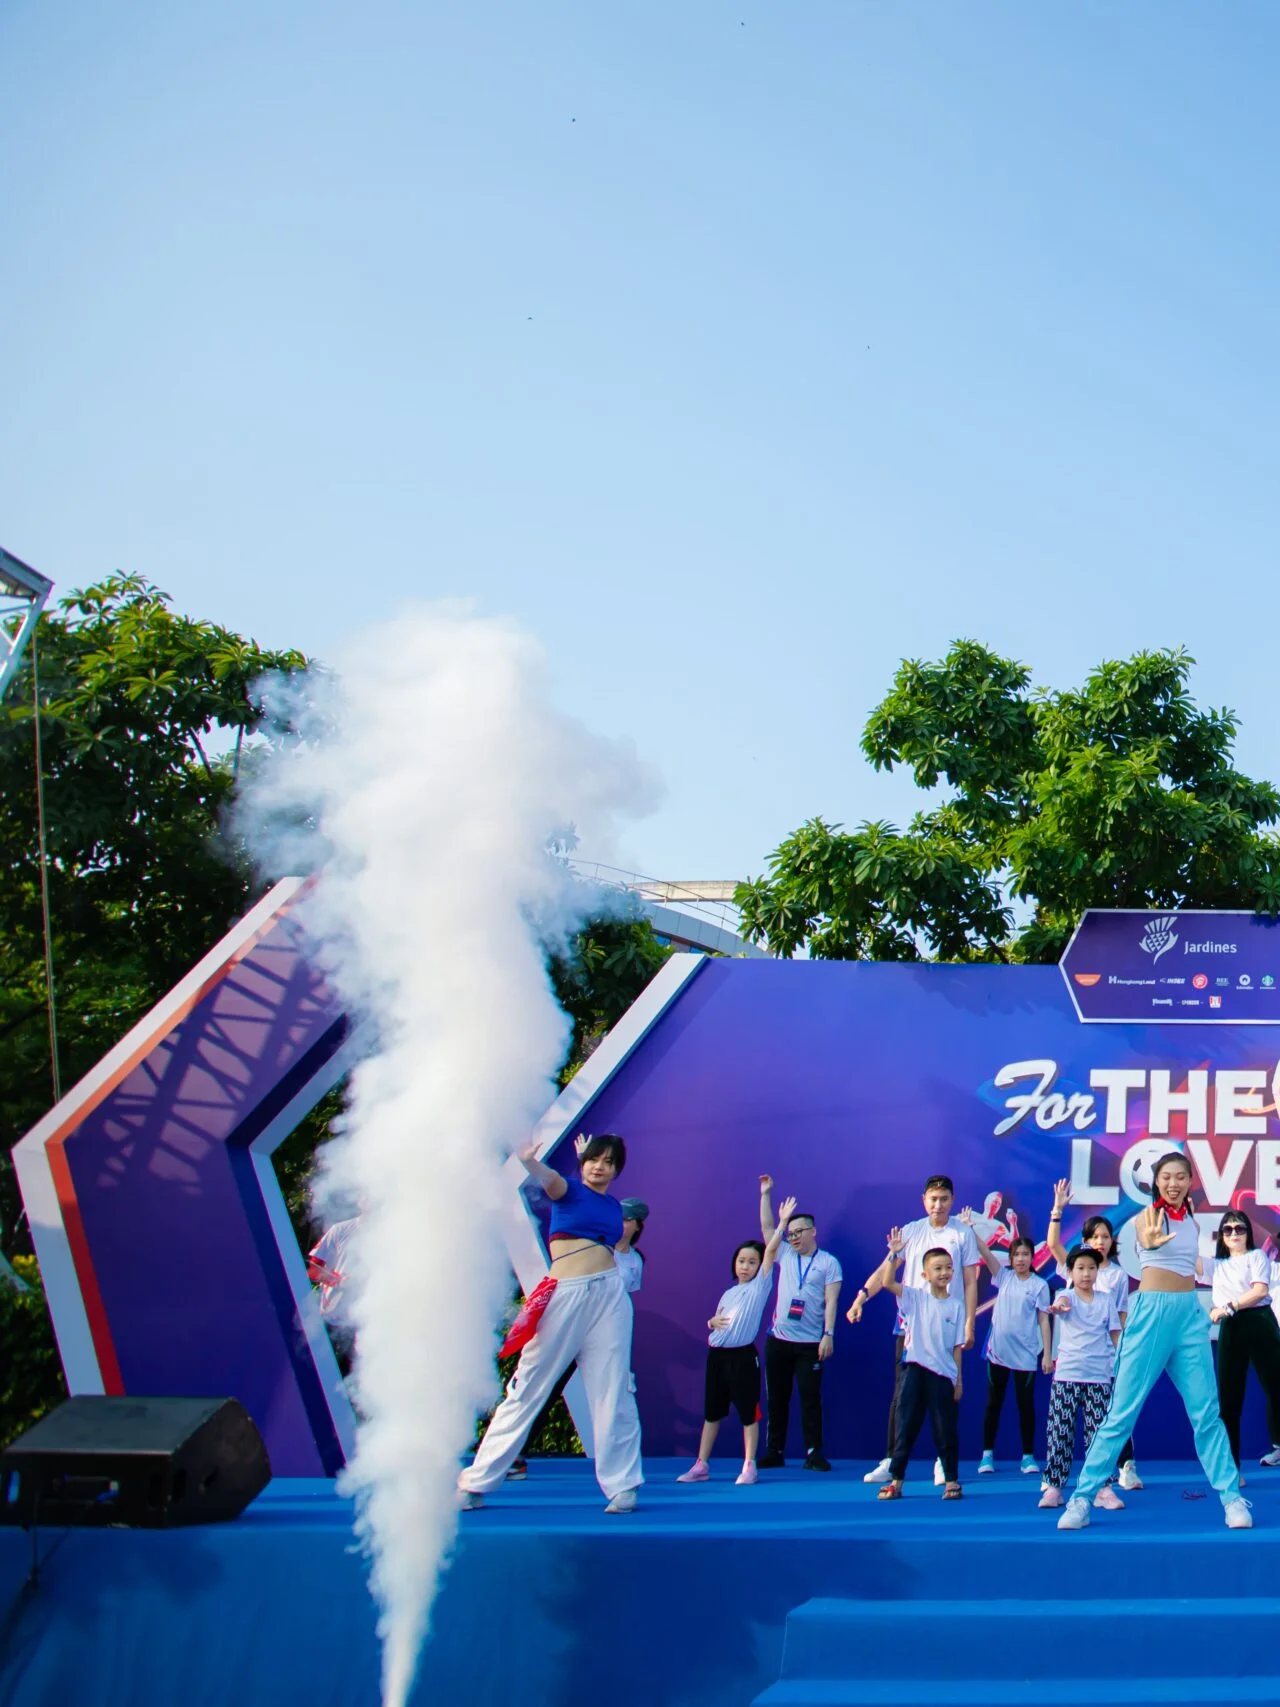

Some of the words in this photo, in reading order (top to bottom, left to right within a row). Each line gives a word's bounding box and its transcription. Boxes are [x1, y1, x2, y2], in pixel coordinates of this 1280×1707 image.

[1184, 940, 1237, 955] Jardines
[993, 1059, 1096, 1136] For
[1089, 1069, 1267, 1135] THE
